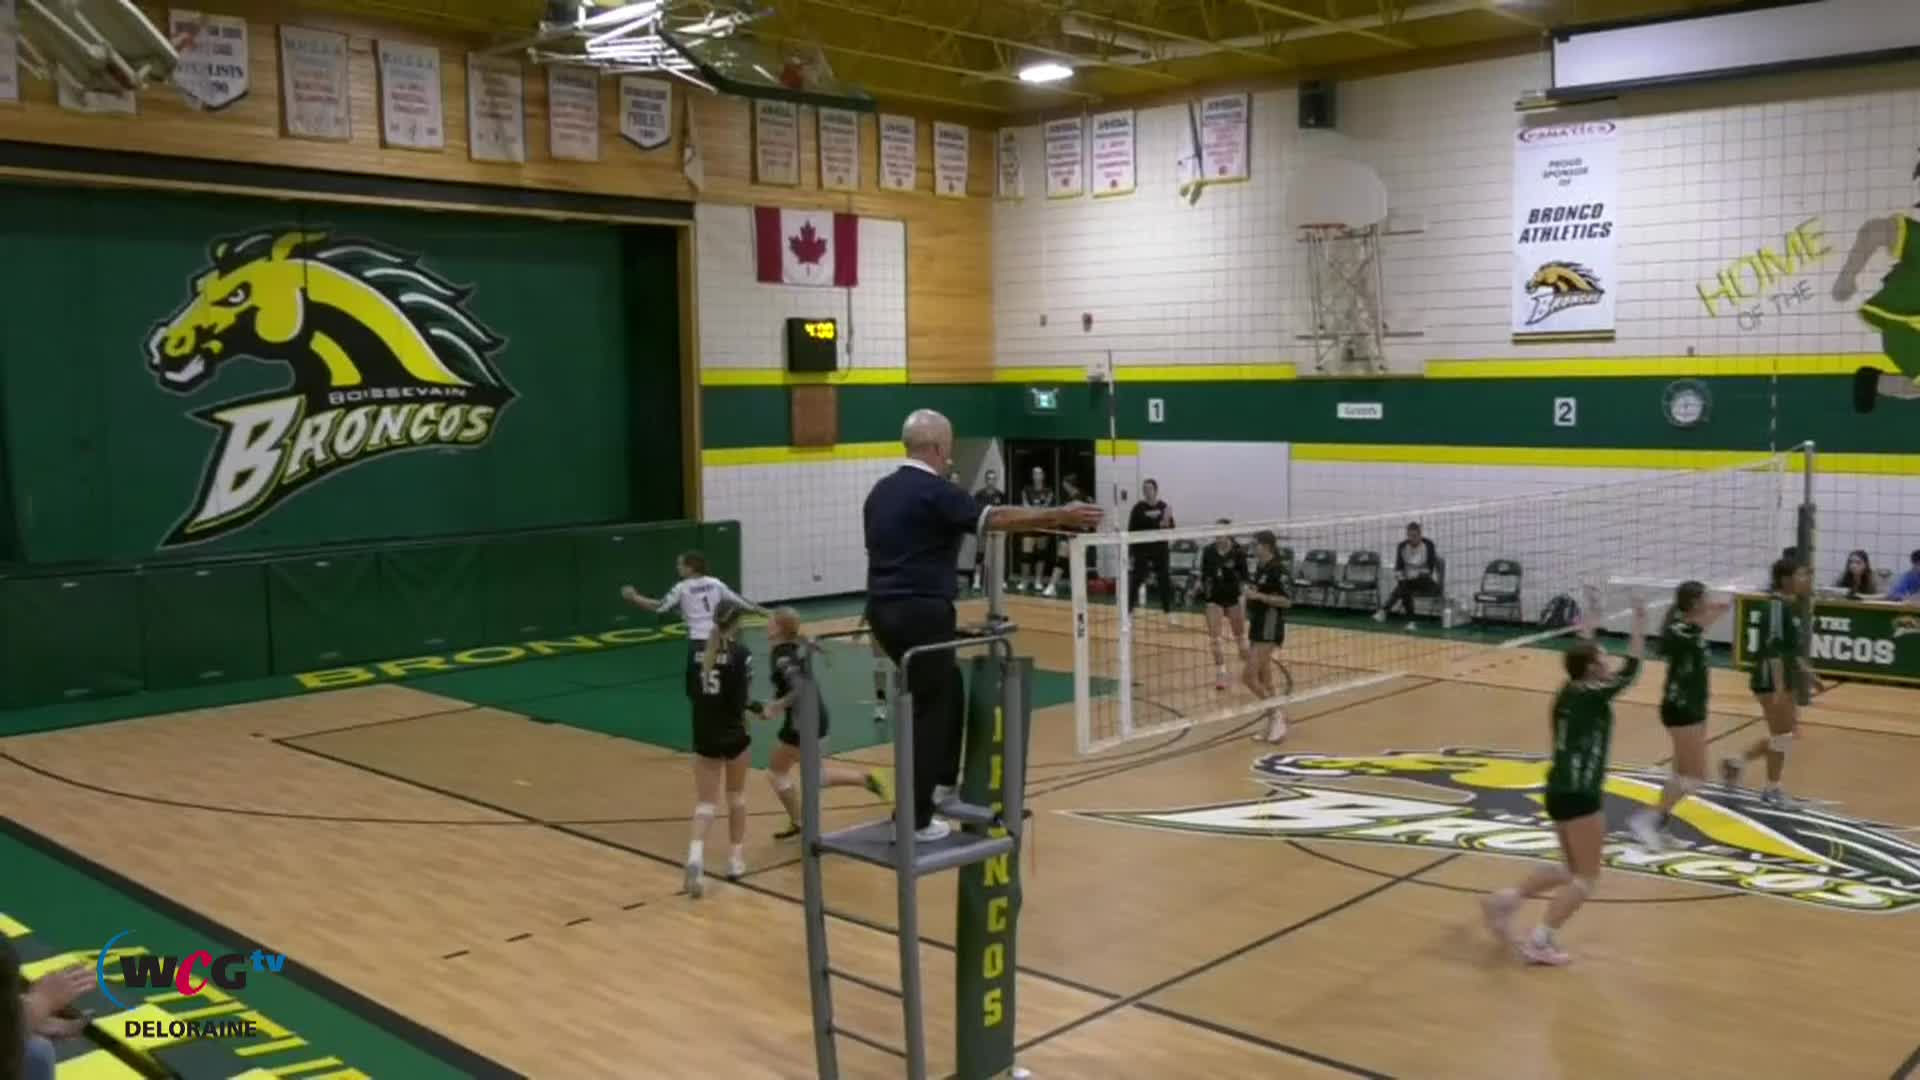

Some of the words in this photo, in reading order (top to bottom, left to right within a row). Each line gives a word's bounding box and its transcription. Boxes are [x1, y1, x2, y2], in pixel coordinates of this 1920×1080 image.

[1527, 202, 1605, 225] BRONCO
[1517, 220, 1614, 245] ATHLETICS
[1695, 215, 1832, 318] HOME
[1737, 303, 1765, 332] OF
[1771, 279, 1816, 315] THE
[328, 386, 468, 404] BOISSEVAIN
[1151, 402, 1161, 420] 1
[1558, 401, 1573, 423] 2
[184, 393, 497, 535] BRONCOS
[702, 595, 711, 612] 1
[700, 669, 721, 695] 15
